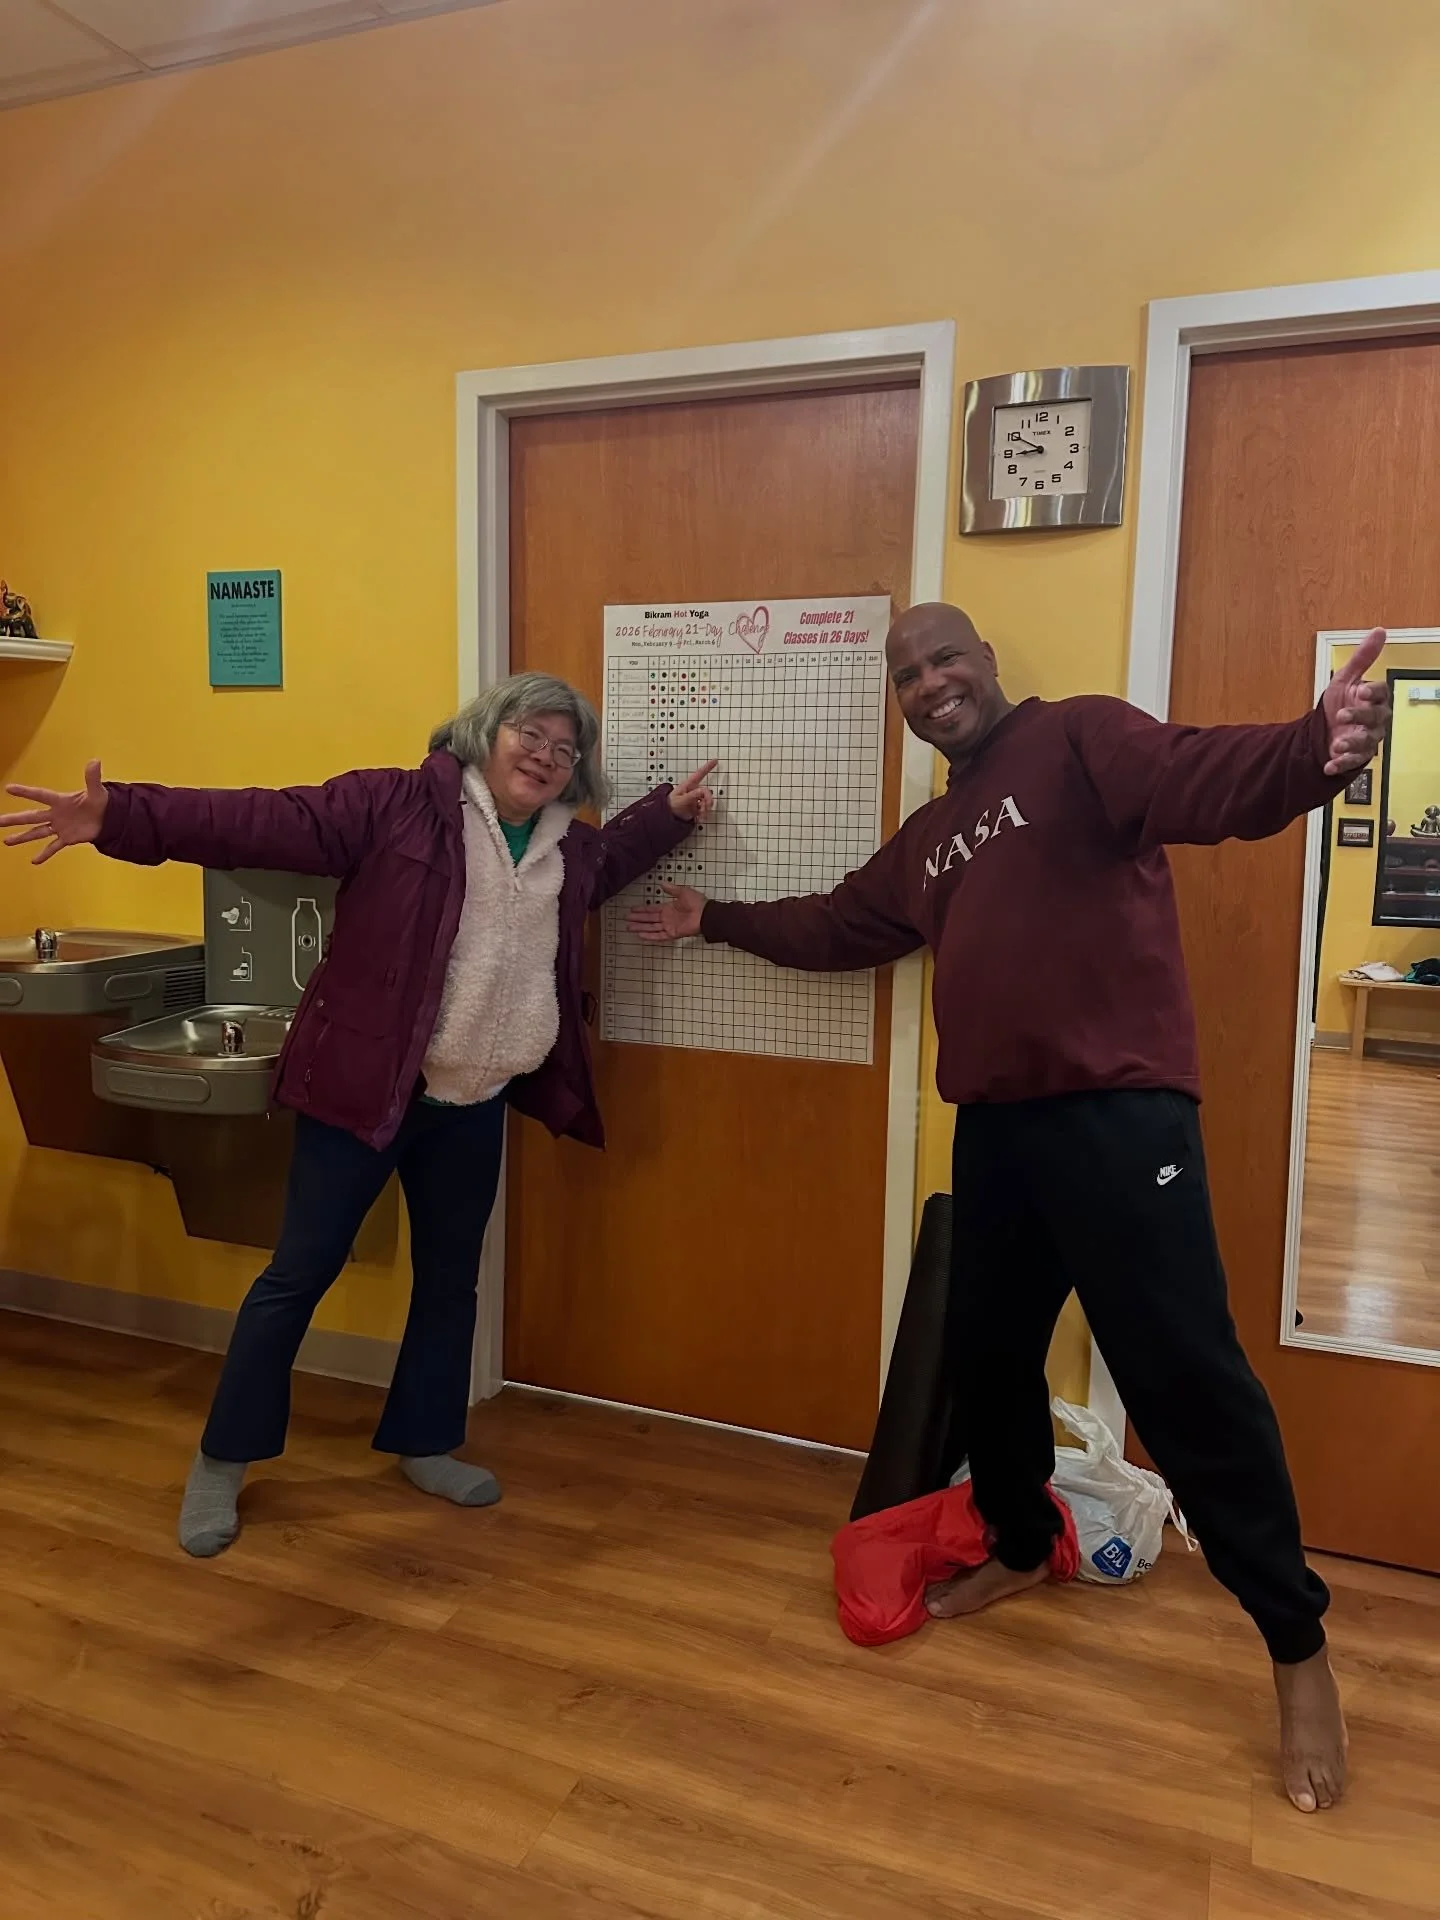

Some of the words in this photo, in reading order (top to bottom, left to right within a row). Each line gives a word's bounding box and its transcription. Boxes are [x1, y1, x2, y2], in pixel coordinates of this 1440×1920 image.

[1035, 411, 1048, 423] 12
[1056, 414, 1060, 425] 1
[1021, 419, 1031, 429] 11
[1007, 431, 1021, 442] 10
[1064, 425, 1075, 437] 2
[1003, 449, 1013, 459] 9
[1069, 443, 1080, 454] 3
[1007, 464, 1018, 475] 8
[1063, 460, 1074, 470] 4
[1019, 477, 1028, 487] 7
[1051, 473, 1062, 483] 5
[1034, 480, 1045, 490] 6
[210, 580, 275, 600] NAMASTE
[644, 611, 672, 619] Bikram
[673, 610, 687, 618] Hot
[689, 609, 709, 619] Yoga
[799, 611, 842, 626] Complete
[843, 610, 854, 624] 21
[615, 625, 641, 637] 2026
[783, 631, 819, 645] Classes
[819, 629, 829, 644] in
[829, 630, 843, 643] 26
[843, 629, 869, 645] Days!
[923, 795, 1030, 893] NASA
[1159, 1164, 1177, 1178] NIKE
[1136, 1558, 1153, 1570] Be
